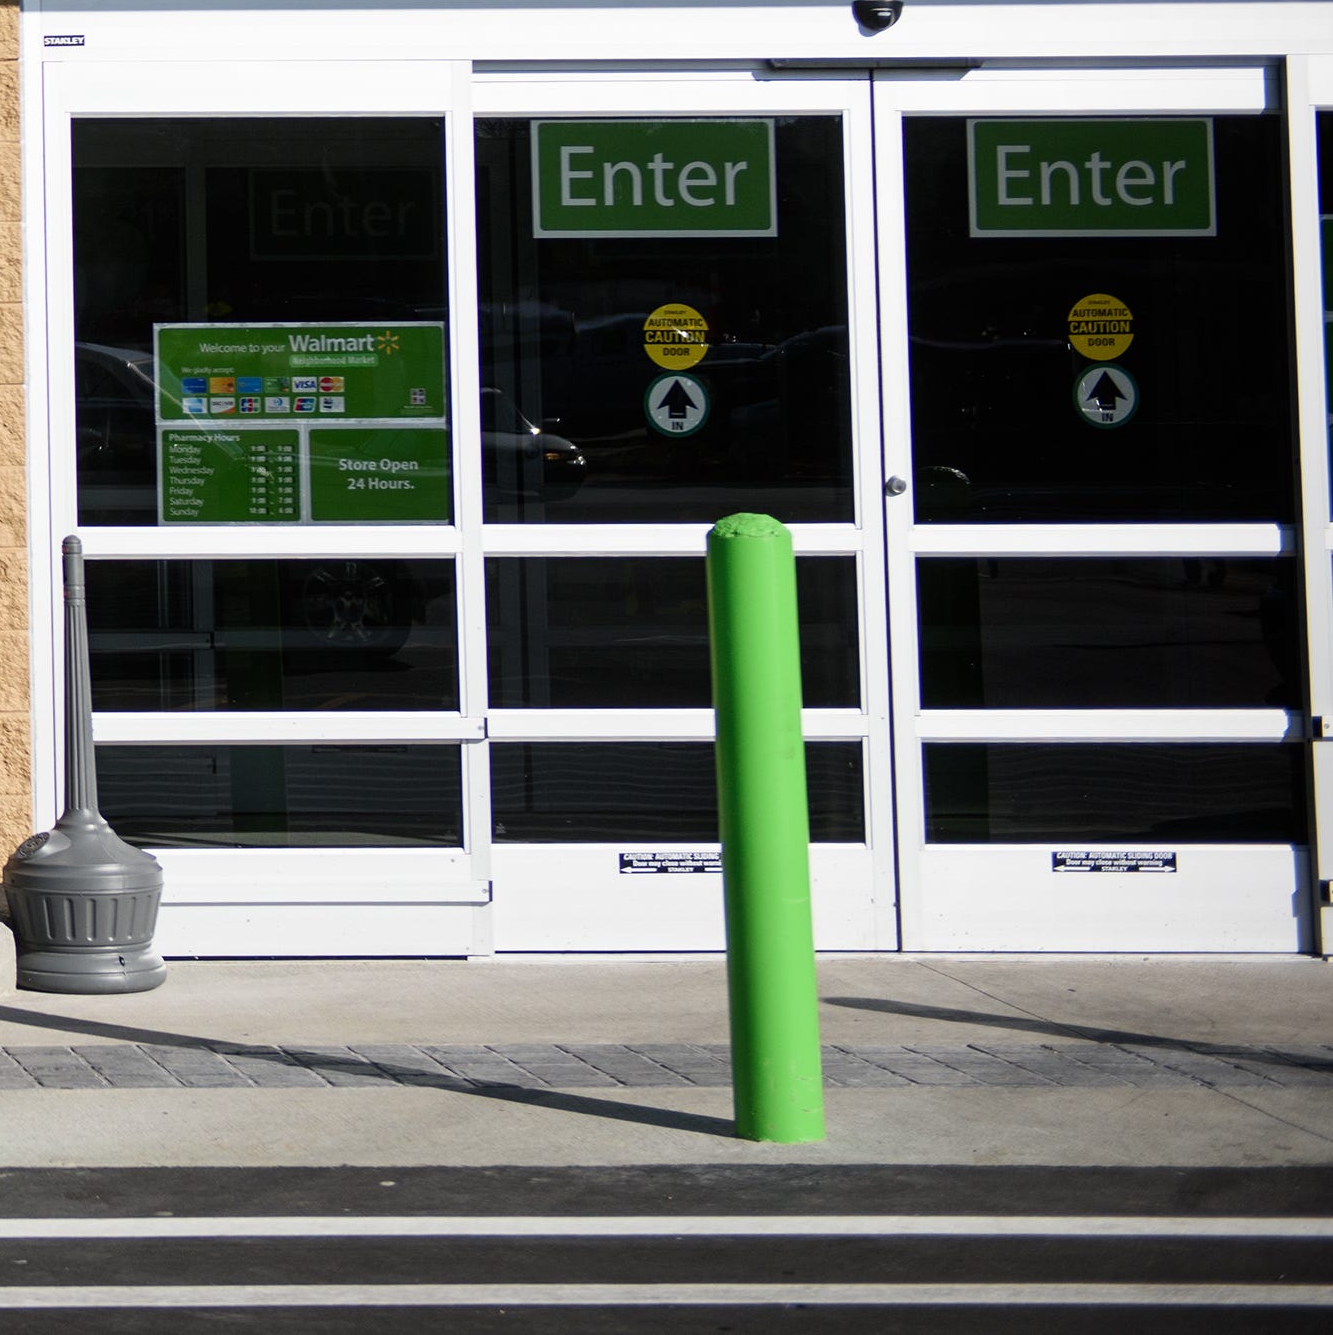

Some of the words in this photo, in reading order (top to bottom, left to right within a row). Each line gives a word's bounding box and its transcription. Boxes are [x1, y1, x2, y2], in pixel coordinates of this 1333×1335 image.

[559, 145, 748, 208] Enter
[995, 144, 1186, 207] Enter
[270, 189, 417, 238] Enter
[1073, 308, 1128, 317] AUTOMATIC
[648, 318, 703, 327] AUTOMATIC
[1070, 321, 1130, 333] CAUTION
[645, 331, 705, 343] CAUTION
[199, 343, 246, 353] Welcome
[249, 344, 259, 352] to
[261, 345, 285, 355] your
[288, 334, 375, 352] Walmart
[1088, 338, 1115, 346] DOOR
[663, 347, 690, 356] DOOR
[295, 381, 316, 389] VISA
[1101, 413, 1113, 422] IN
[672, 421, 684, 430] IN
[169, 434, 212, 442] Pharmacy
[169, 446, 201, 455] Monday
[169, 456, 201, 465] Tuesday
[339, 458, 376, 470] Store
[380, 458, 419, 473] Open
[169, 467, 214, 475] Wednesday
[170, 477, 205, 485] Thursday
[347, 478, 365, 489] 24
[368, 478, 415, 489] Hours.
[169, 487, 193, 496] Friday
[170, 497, 204, 506] Saturday
[170, 507, 199, 517] Sunday
[655, 852, 693, 860] AUTOMATIC
[1138, 859, 1163, 867] warning
